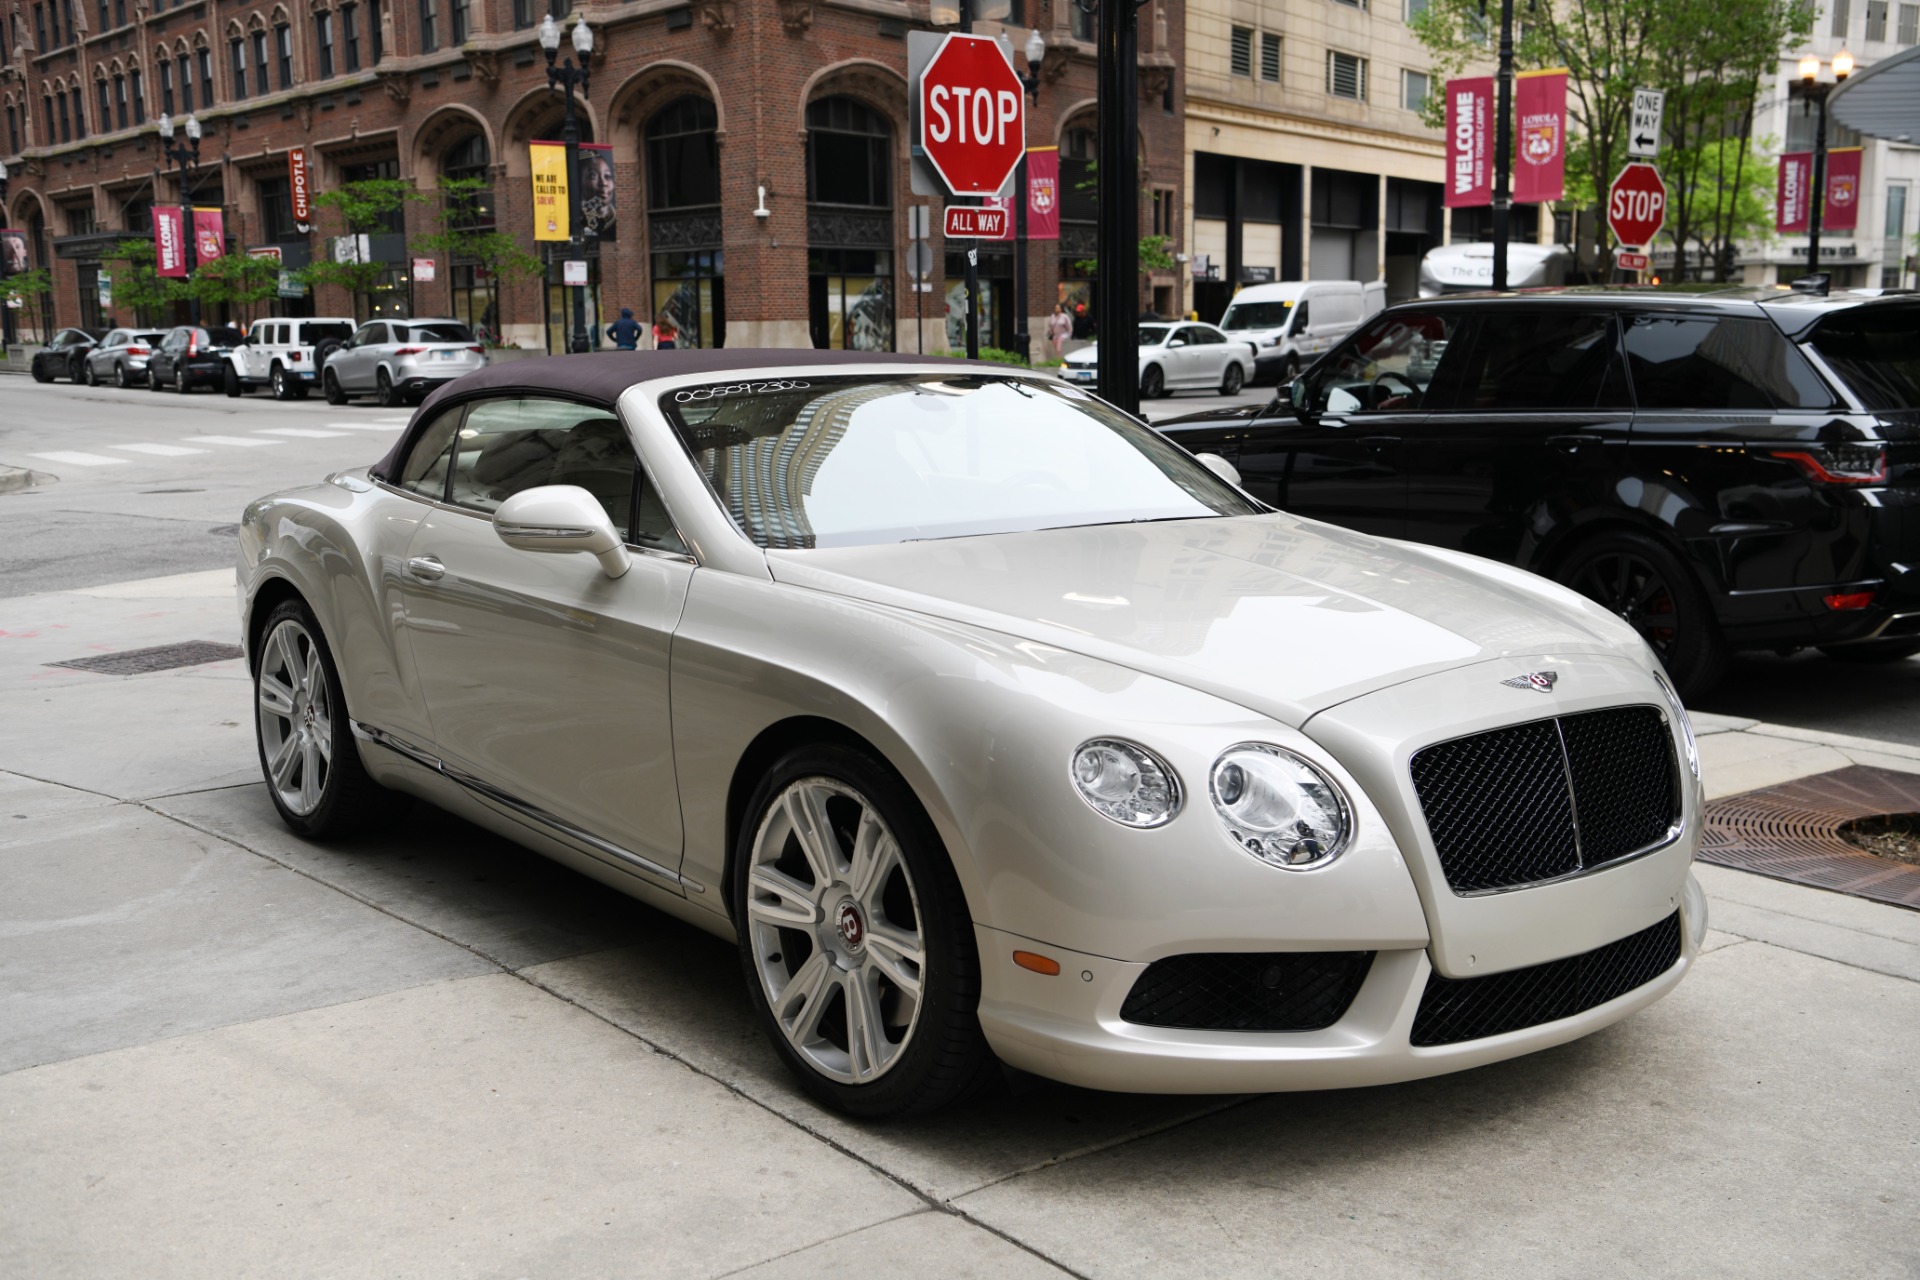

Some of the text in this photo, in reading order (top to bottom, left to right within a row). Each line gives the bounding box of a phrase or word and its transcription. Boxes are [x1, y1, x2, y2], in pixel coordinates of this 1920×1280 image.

[1636, 95, 1660, 112] ONE
[929, 84, 1018, 145] STOP
[1522, 113, 1559, 125] LOYOLA
[1634, 113, 1659, 130] WAY
[1455, 91, 1474, 195] WELCOME
[293, 152, 307, 218] CHIPOTLE
[535, 175, 557, 183] WE ARE
[536, 185, 566, 194] CALLED TO
[1783, 160, 1799, 225] WELCOME
[1612, 188, 1662, 222] STOP
[951, 213, 1001, 232] ALL WAY
[159, 214, 174, 270] WELCOME
[1621, 255, 1646, 267] ALL WAY
[1452, 267, 1473, 276] The
[675, 380, 810, 402] 005092300
